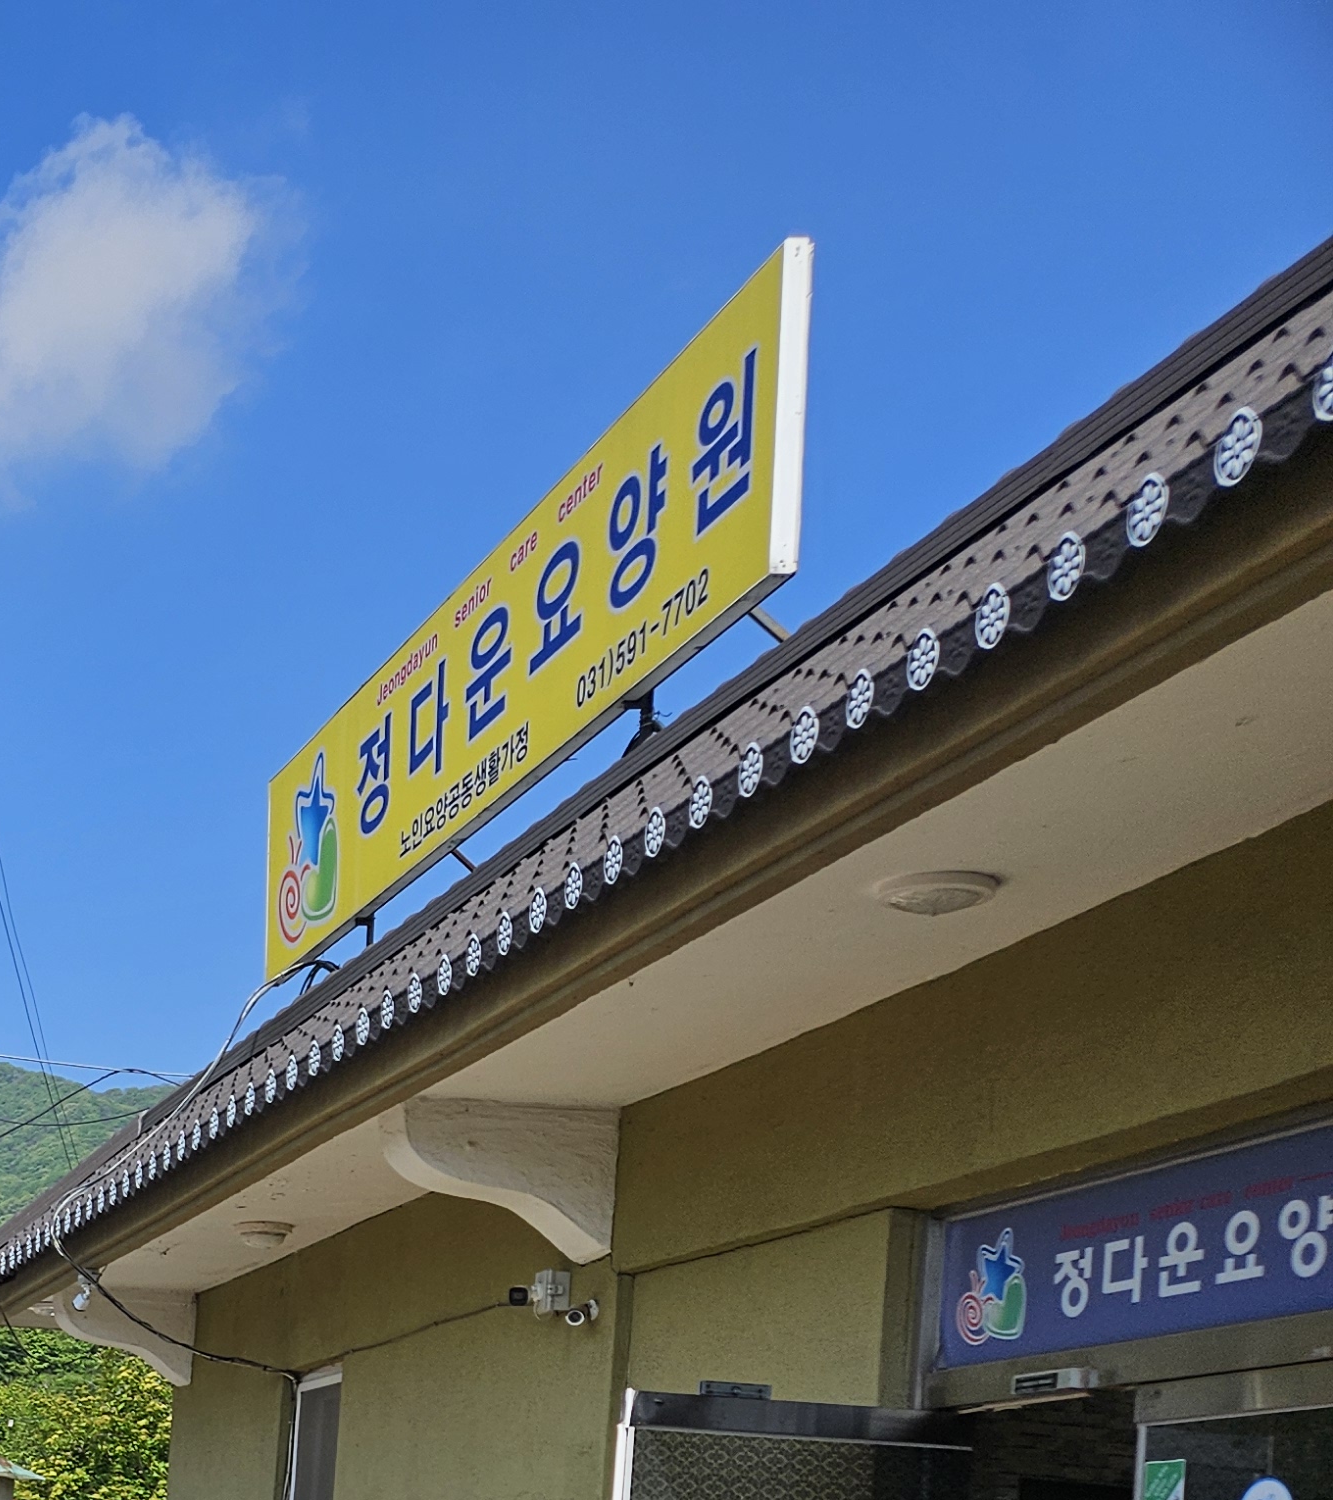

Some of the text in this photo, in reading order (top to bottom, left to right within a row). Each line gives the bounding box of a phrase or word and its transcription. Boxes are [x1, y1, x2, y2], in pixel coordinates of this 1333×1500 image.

[357, 347, 757, 835] 정다운요양원
[454, 577, 493, 629] senior
[509, 531, 538, 572] care
[557, 463, 603, 523] center
[576, 567, 709, 708] 031)591-7702
[399, 721, 530, 858] 노인요양공동생활가정
